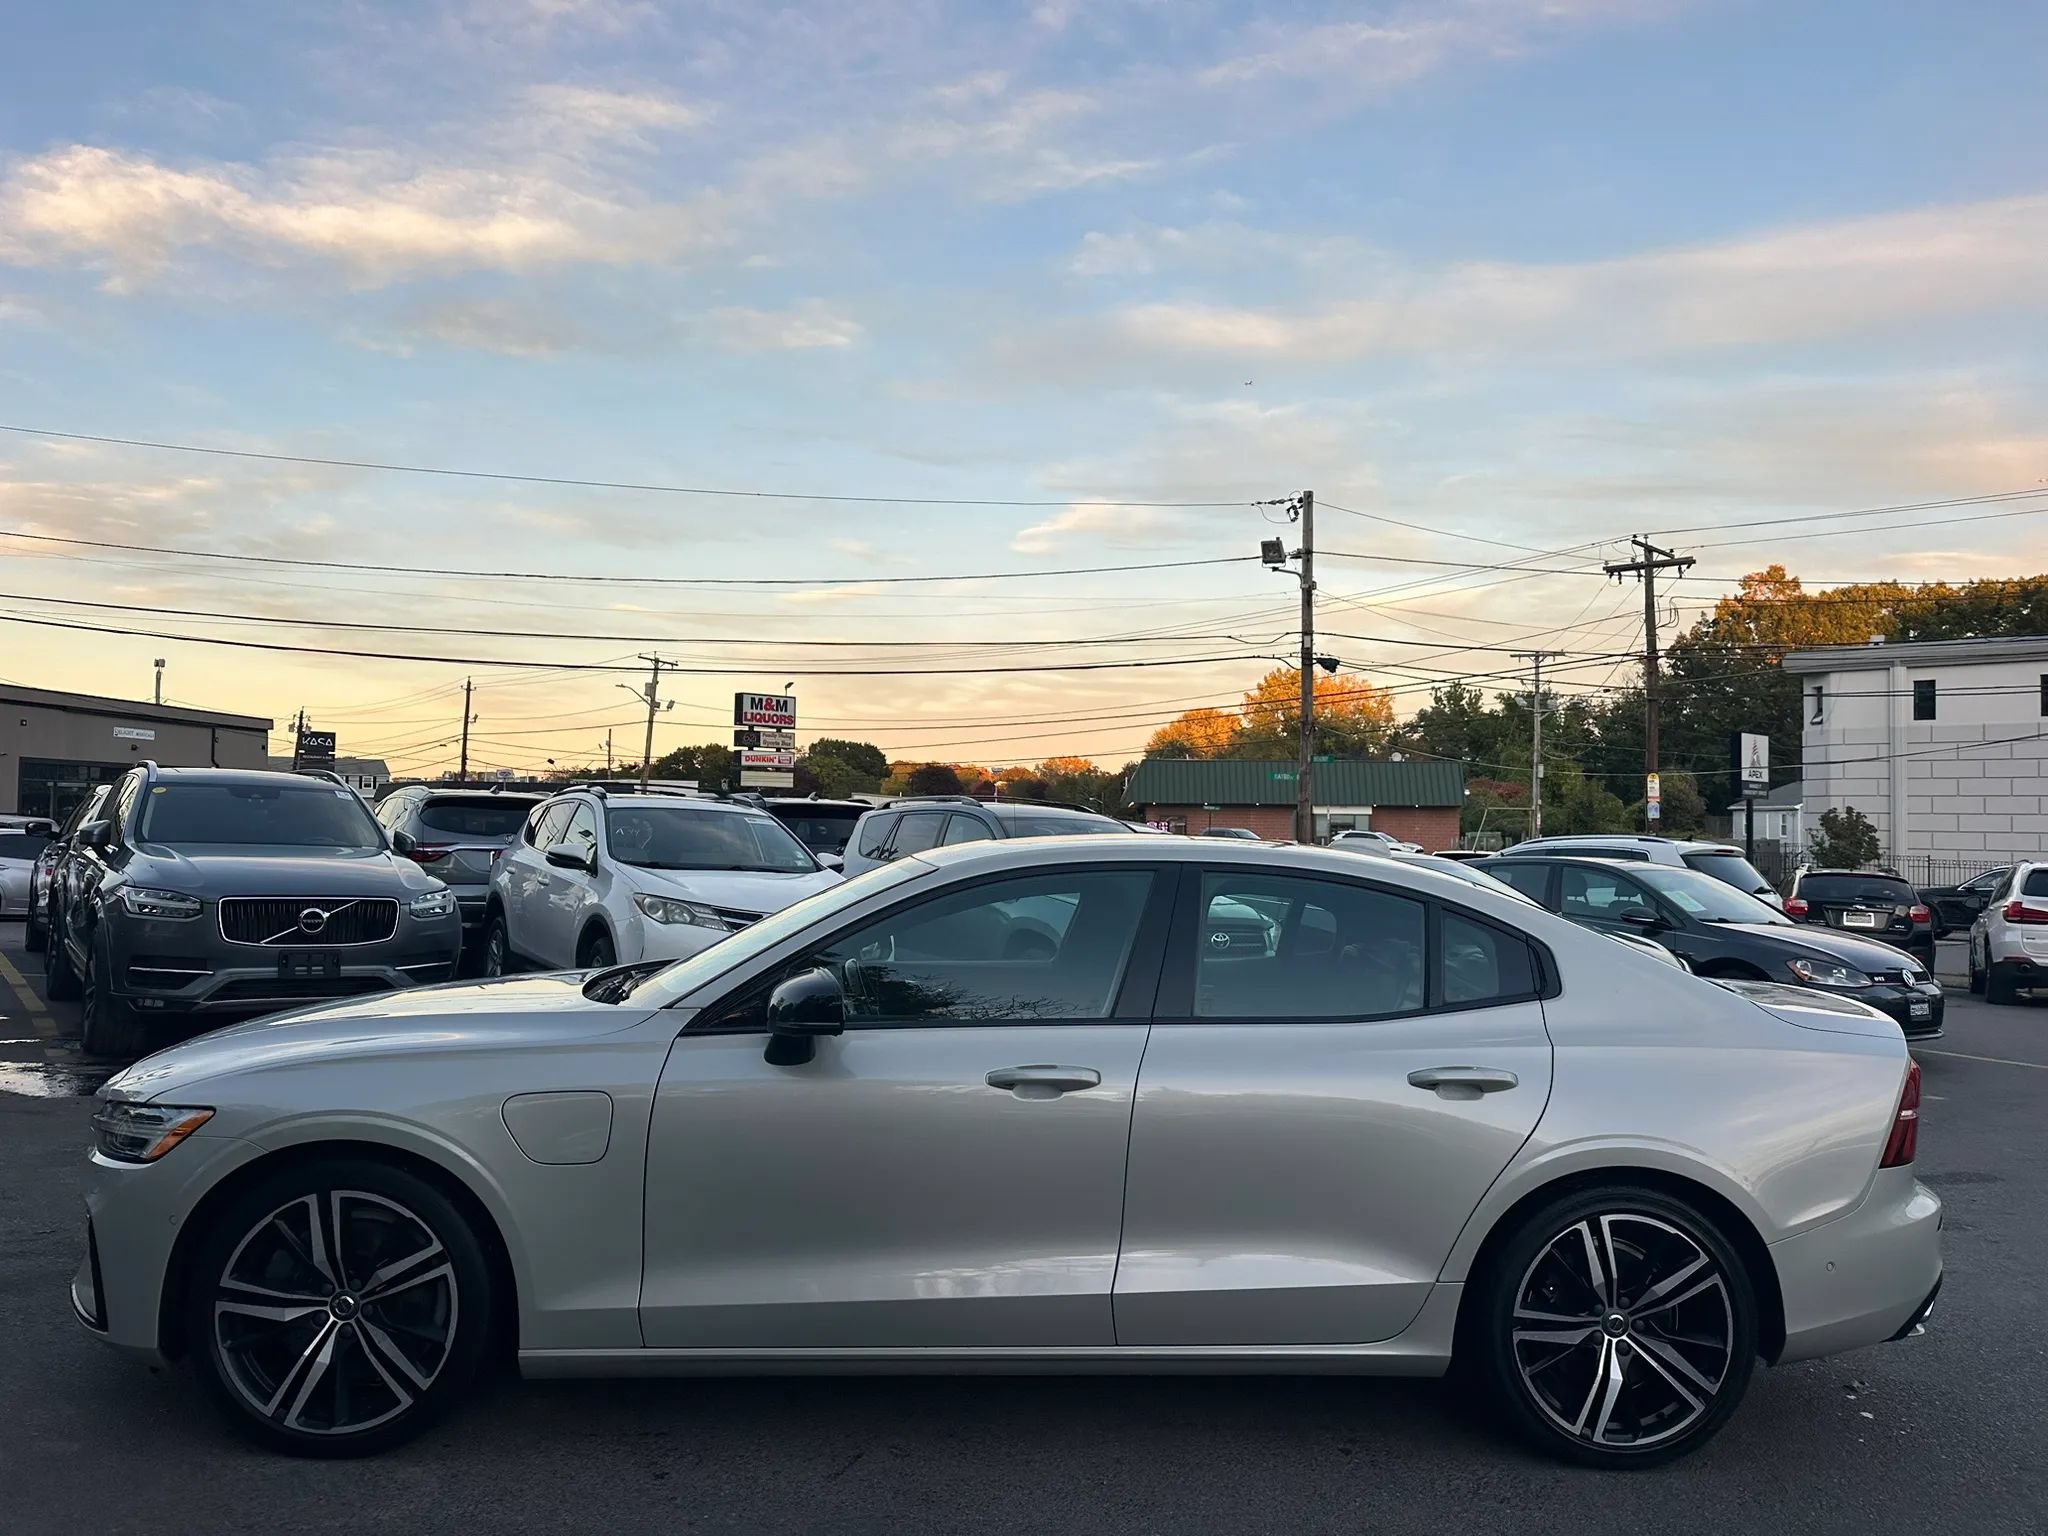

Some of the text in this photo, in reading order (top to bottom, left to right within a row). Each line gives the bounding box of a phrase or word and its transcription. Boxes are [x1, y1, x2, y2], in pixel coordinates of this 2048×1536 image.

[751, 697, 788, 712] M&M
[744, 712, 794, 725] LIQUORS
[745, 755, 777, 763] DUNKIN'
[1748, 770, 1763, 778] APEX
